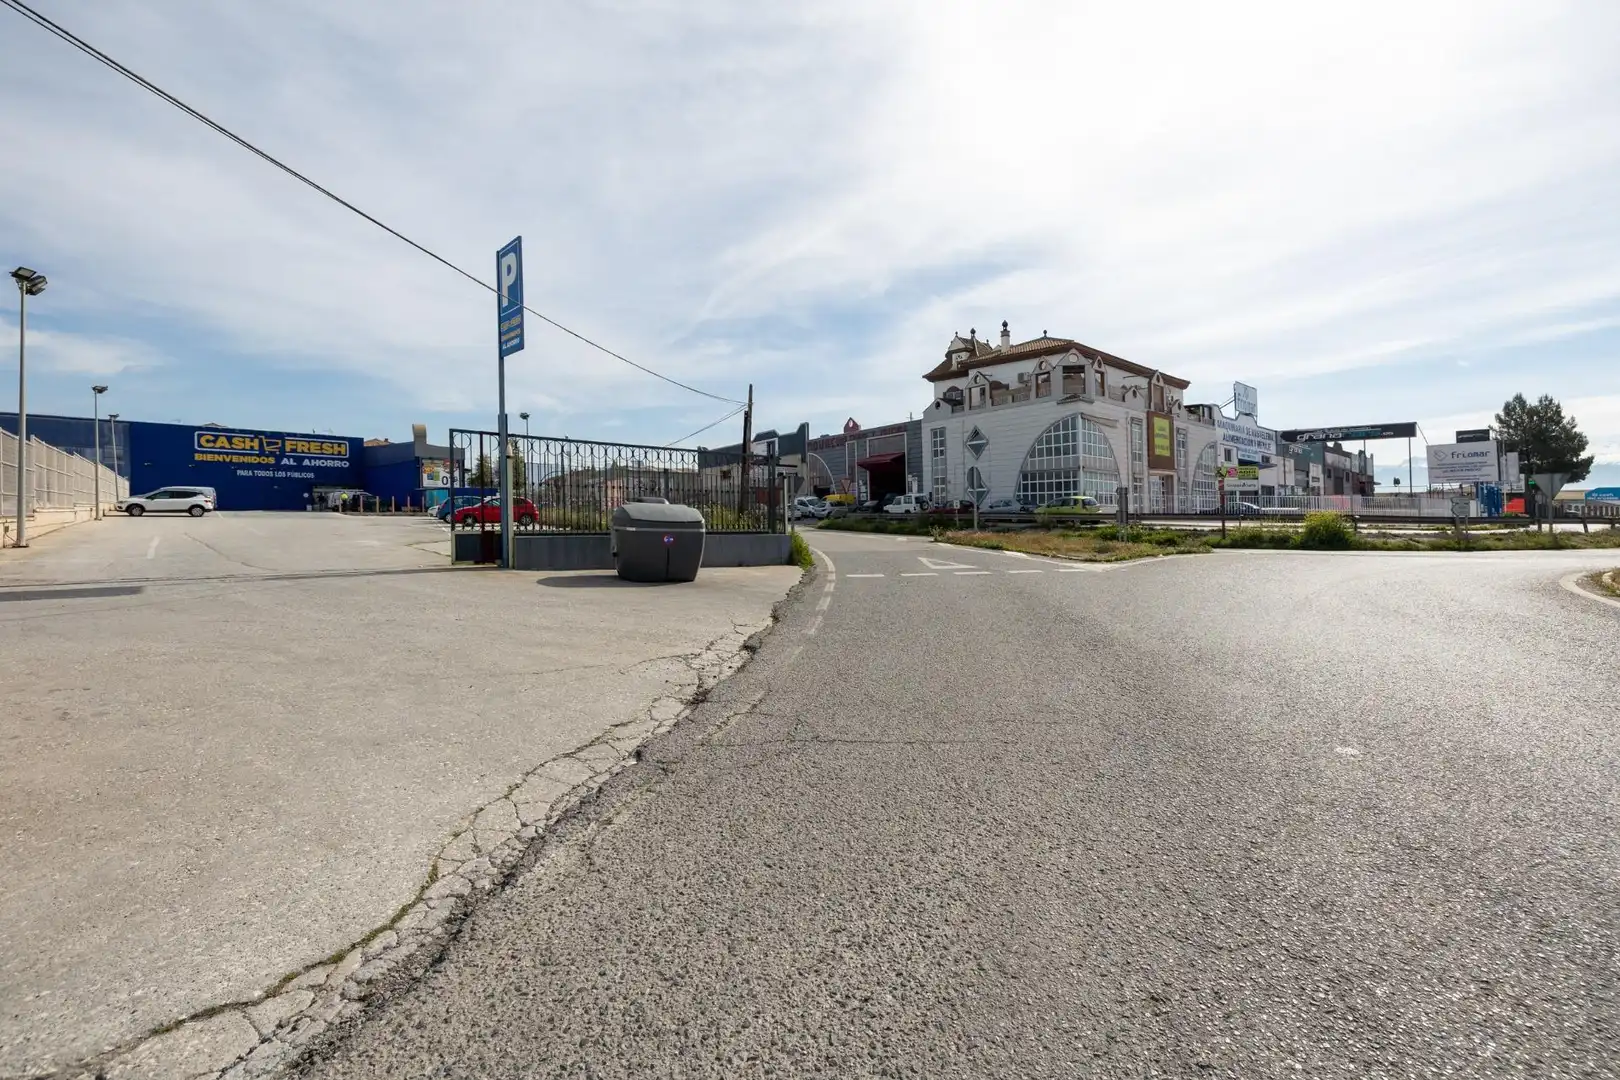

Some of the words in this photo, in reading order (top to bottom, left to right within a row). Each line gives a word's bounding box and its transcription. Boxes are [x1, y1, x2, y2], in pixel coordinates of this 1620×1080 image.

[501, 252, 516, 308] P
[199, 434, 259, 451] CASH
[284, 440, 346, 455] FRESH
[194, 453, 276, 464] BIENVENIDOS
[280, 457, 297, 466] AL
[302, 458, 350, 468] AHORRO
[1451, 450, 1490, 459] Friomar
[236, 469, 253, 477] PARA
[275, 470, 286, 478] LOS
